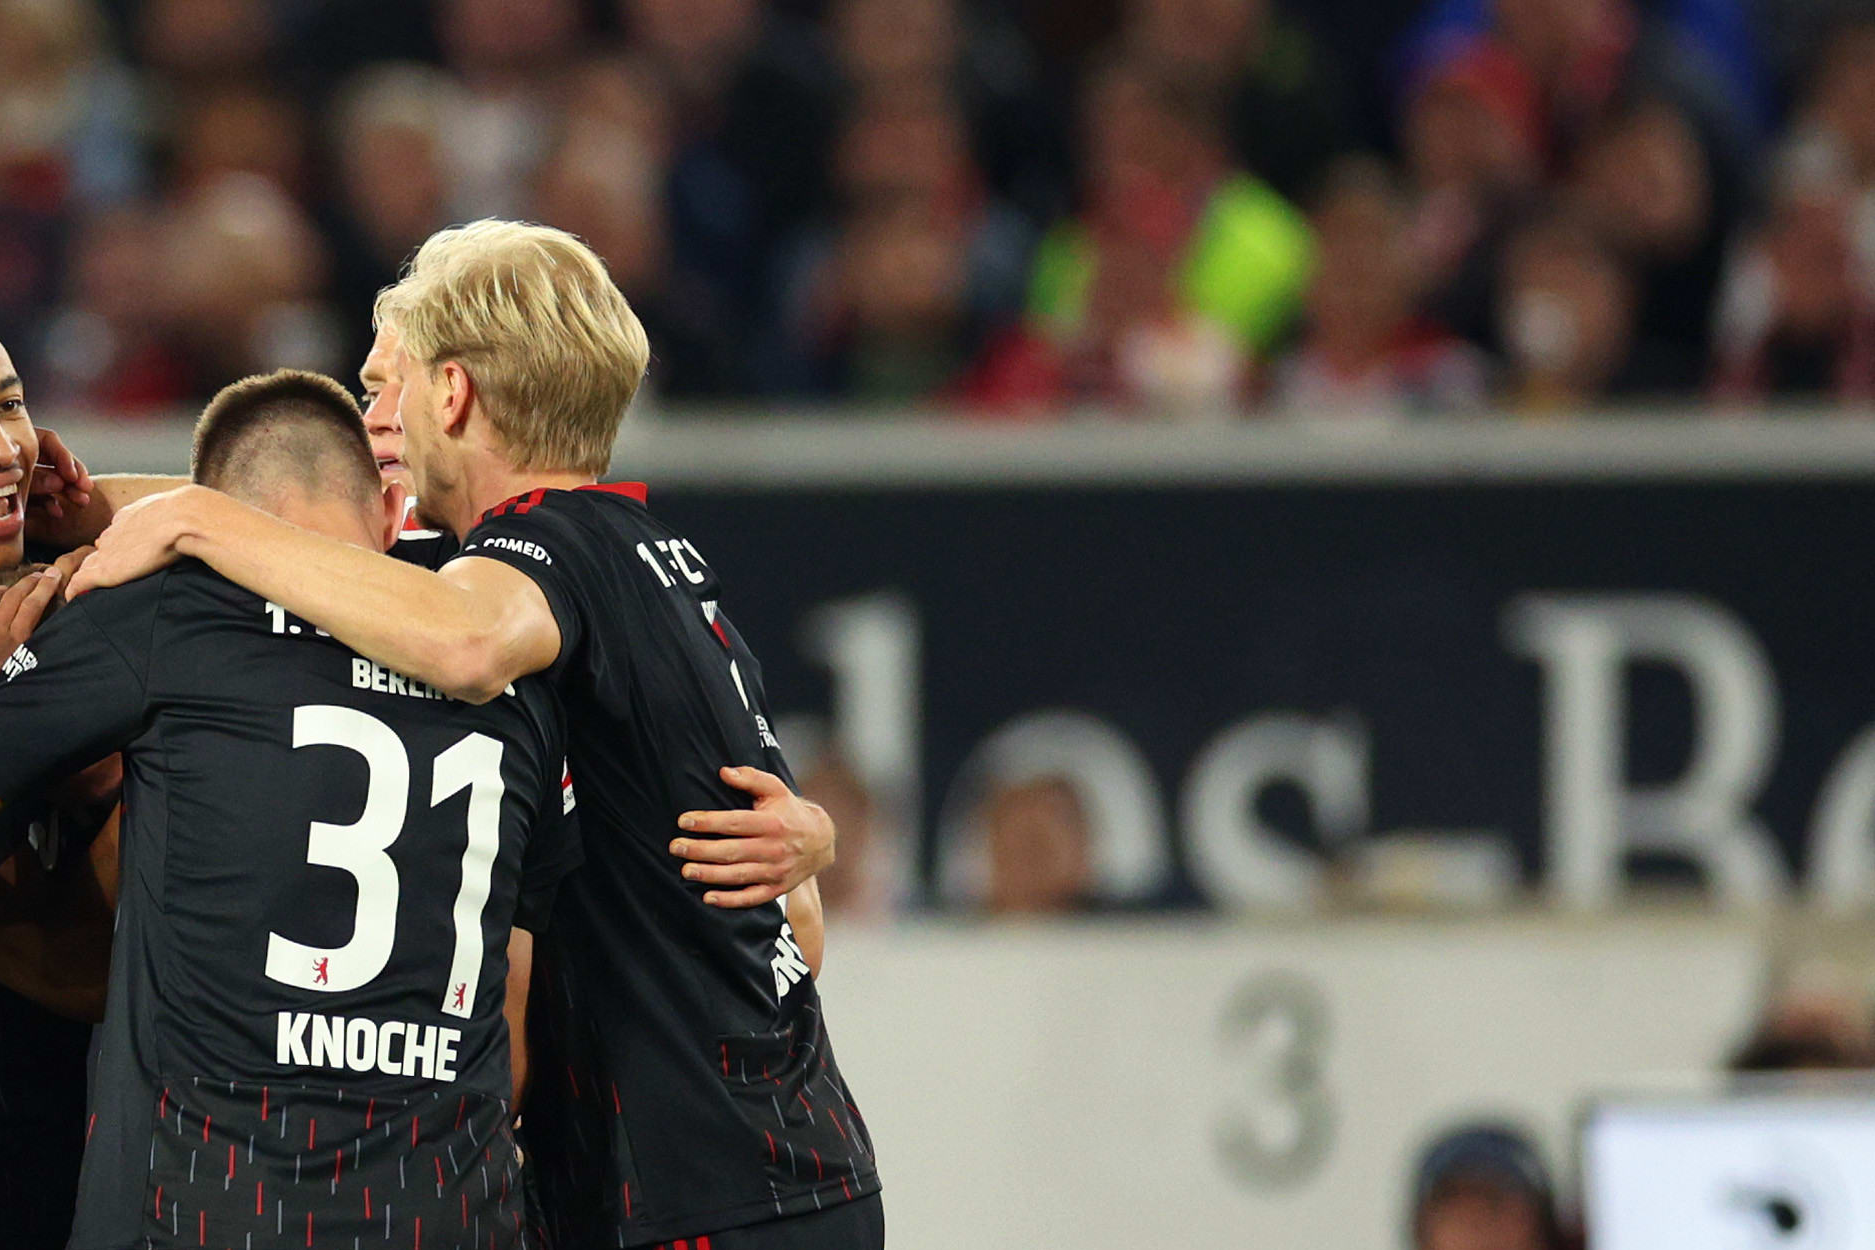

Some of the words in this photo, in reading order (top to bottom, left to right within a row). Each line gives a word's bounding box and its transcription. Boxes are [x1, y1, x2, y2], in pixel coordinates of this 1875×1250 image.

[264, 704, 506, 1019] 31
[276, 1011, 462, 1083] KNOCHE
[1211, 970, 1333, 1195] 3
